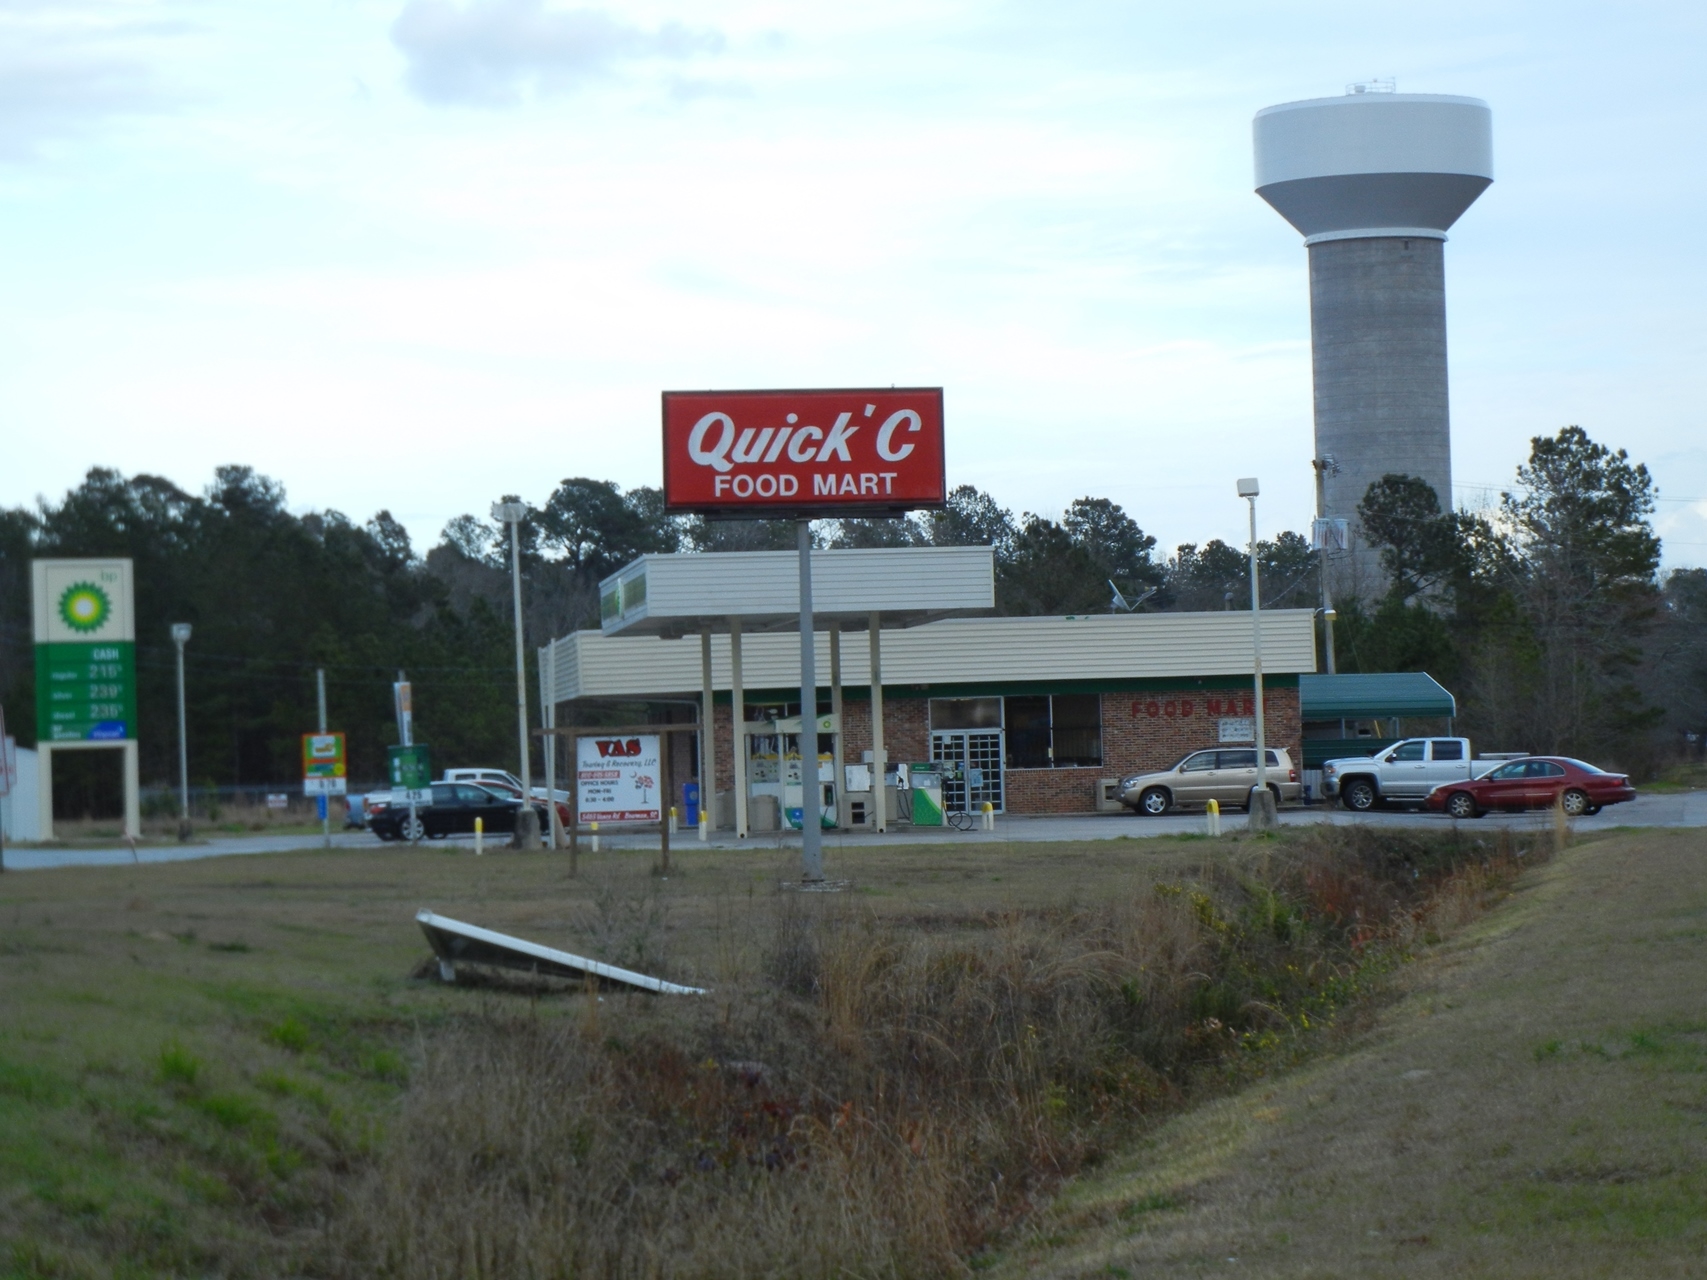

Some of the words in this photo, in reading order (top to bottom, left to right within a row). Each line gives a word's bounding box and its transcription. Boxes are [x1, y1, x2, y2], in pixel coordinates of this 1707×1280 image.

[688, 412, 859, 472] Quick
[714, 474, 798, 497] FOOD
[814, 472, 897, 496] MART
[93, 648, 119, 660] CASH
[1131, 701, 1194, 718] FOOD
[595, 738, 642, 758] VAS
[644, 758, 656, 766] LLC
